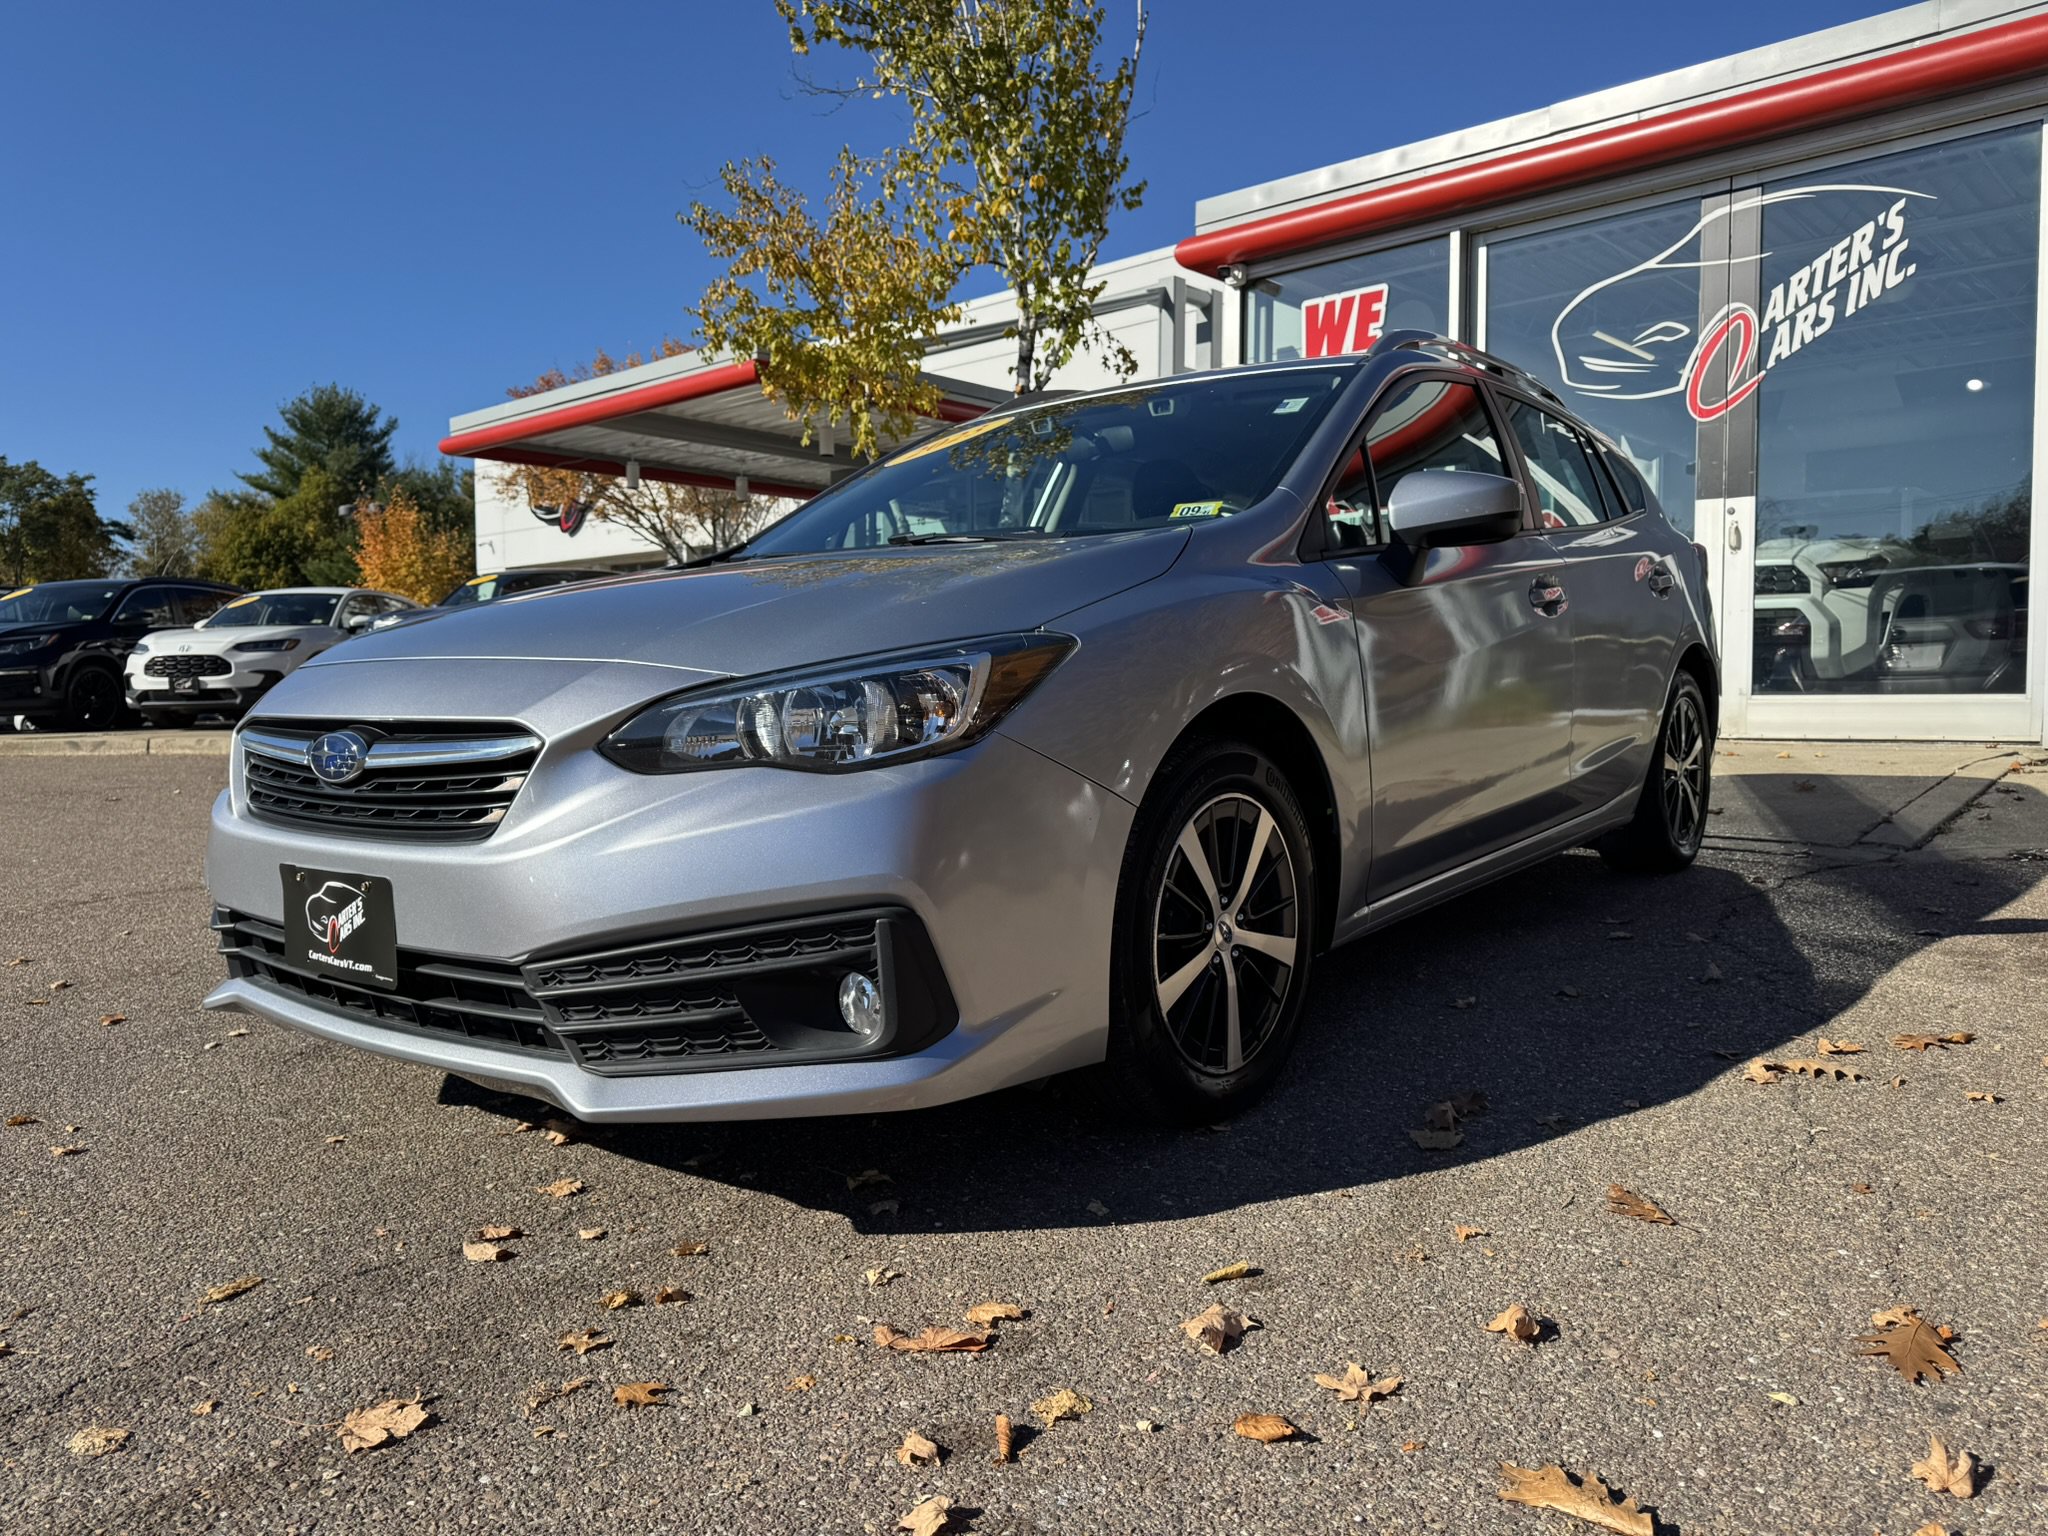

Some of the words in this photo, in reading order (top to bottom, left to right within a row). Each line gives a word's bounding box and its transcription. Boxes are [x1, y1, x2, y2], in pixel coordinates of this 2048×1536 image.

[1845, 238, 1917, 317] INC.
[1304, 287, 1385, 358] WE
[1179, 505, 1202, 517] 09
[308, 949, 373, 973] CartersCarsVT.com
